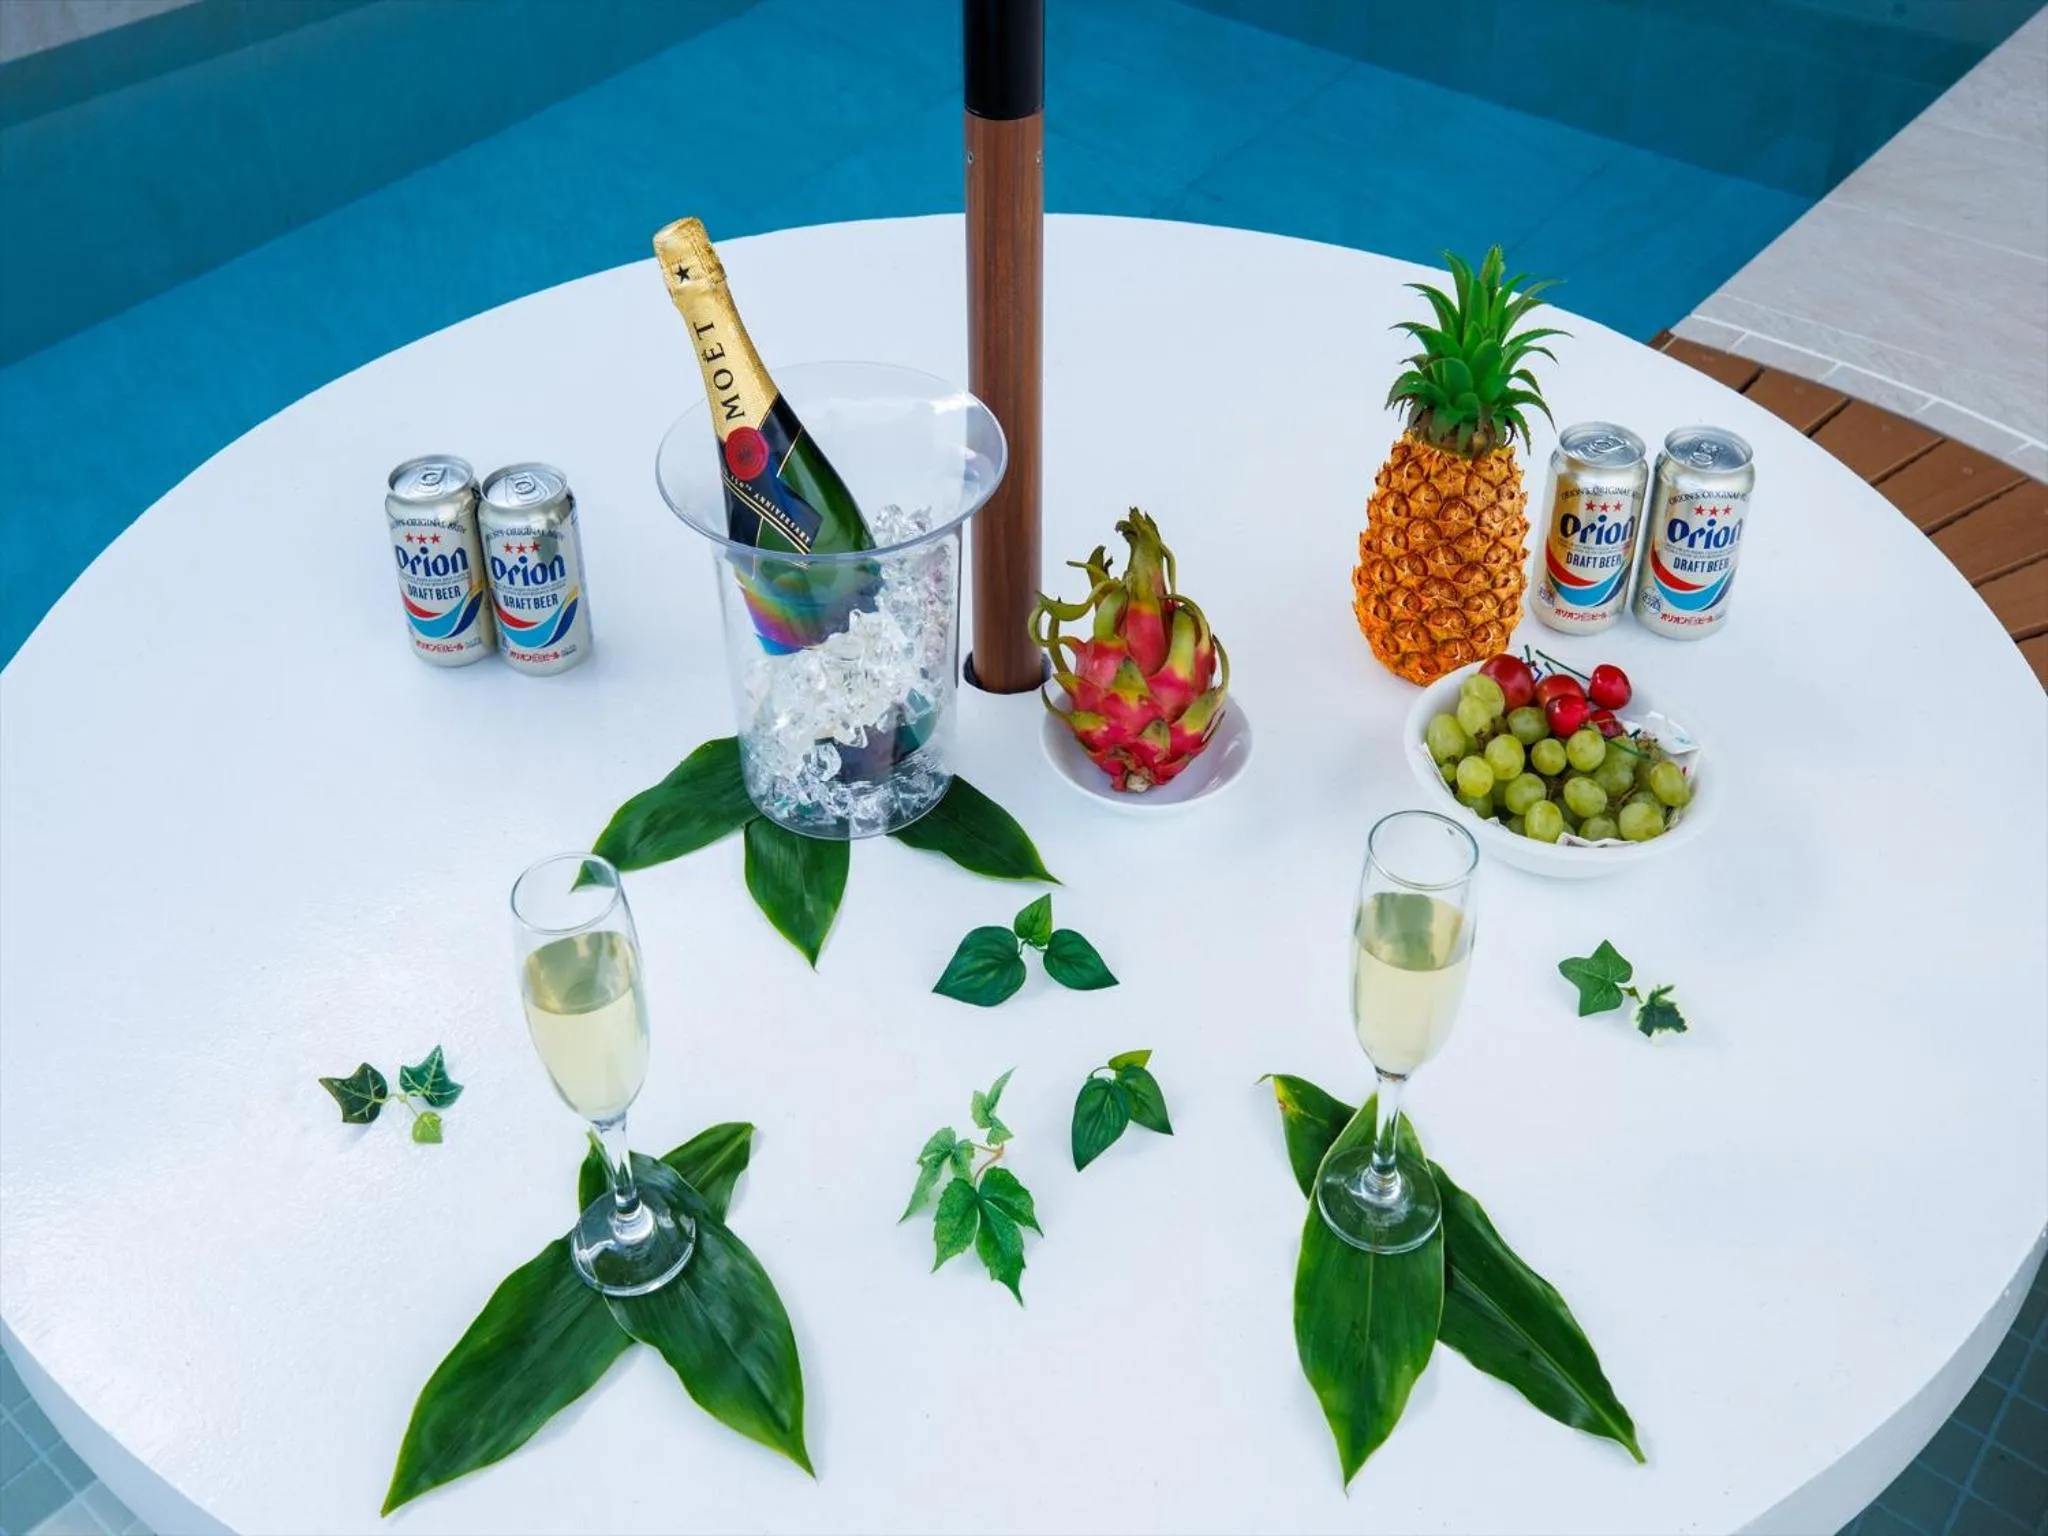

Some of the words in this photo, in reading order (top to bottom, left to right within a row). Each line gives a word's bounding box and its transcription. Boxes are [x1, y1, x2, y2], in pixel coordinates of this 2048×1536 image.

[693, 320, 745, 421] MOËT
[753, 493, 811, 544] ANNIVERSARY
[1560, 512, 1635, 545] Orion
[1667, 517, 1743, 550] Orion
[395, 546, 469, 578] Orion
[490, 554, 566, 587] Orion
[1566, 554, 1597, 569] DRAFT
[1599, 554, 1622, 569] BEER
[1673, 557, 1705, 572] DRAFT
[1707, 556, 1730, 573] BEER
[407, 584, 434, 601] DRAFT
[436, 585, 461, 600] BEER
[503, 594, 531, 610] DRAFT
[533, 593, 559, 610] BEER
